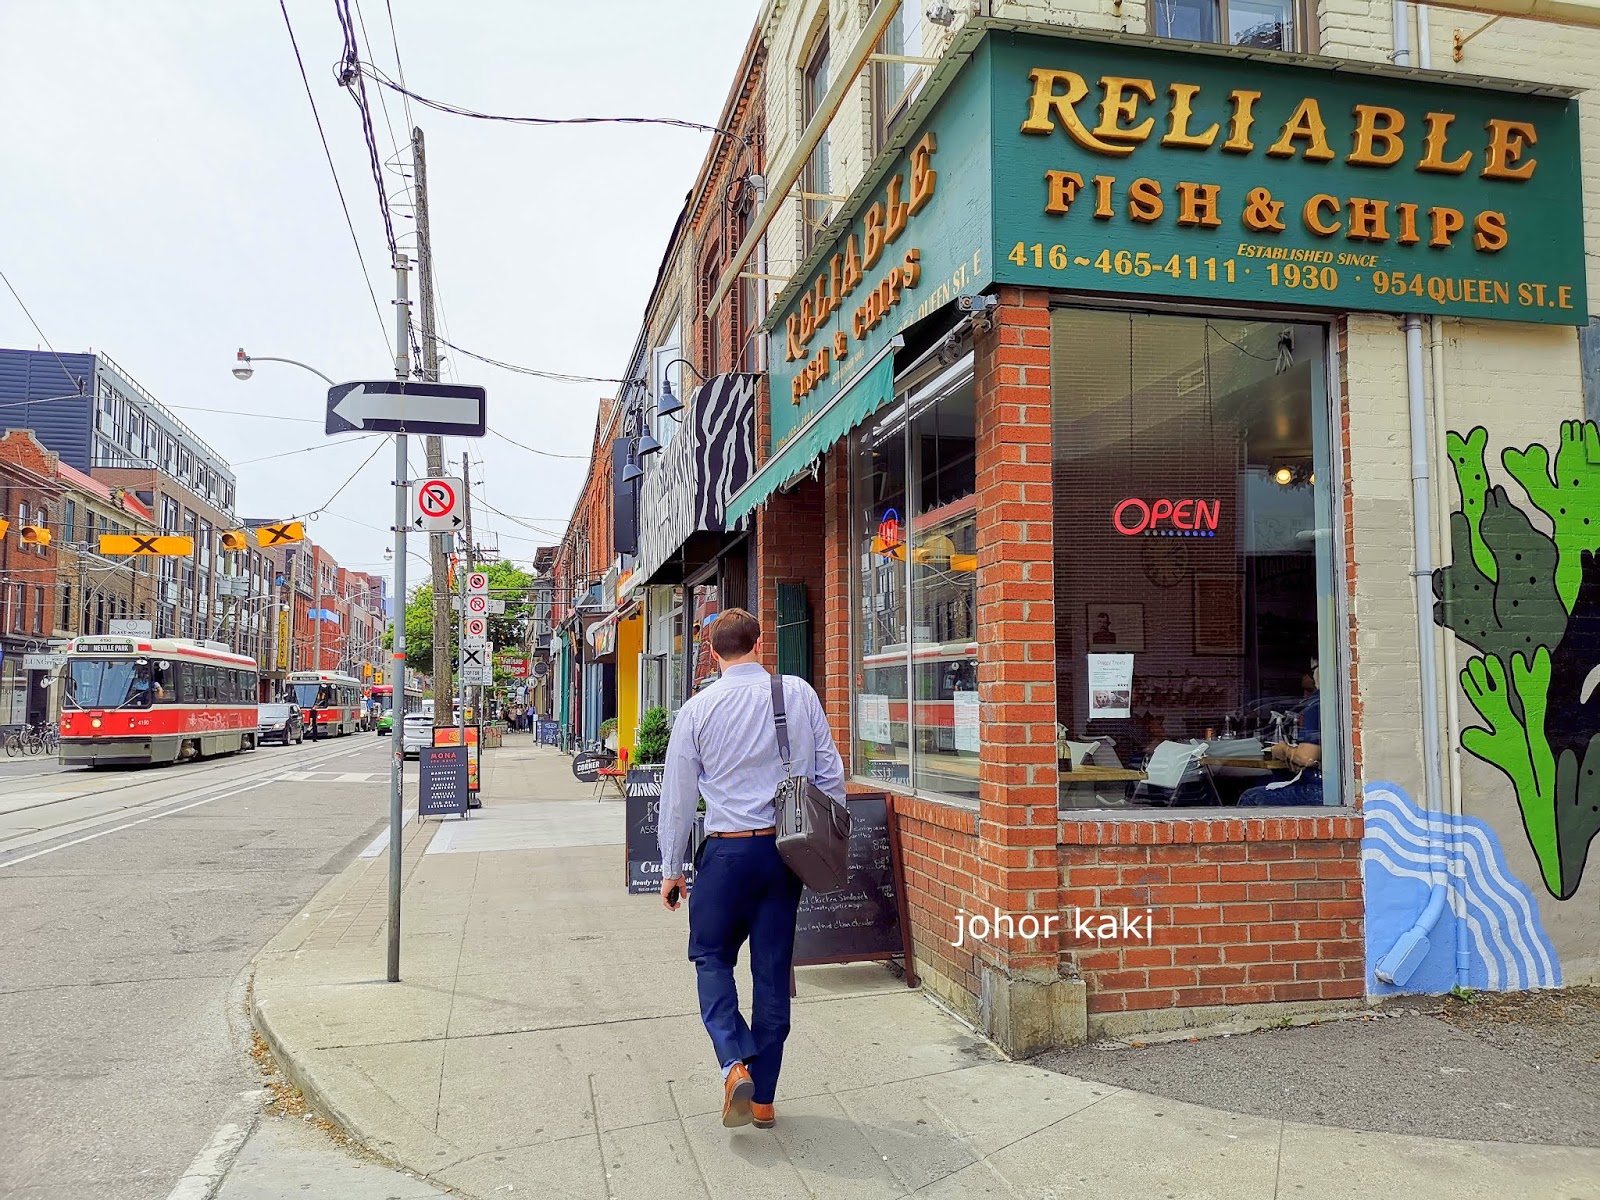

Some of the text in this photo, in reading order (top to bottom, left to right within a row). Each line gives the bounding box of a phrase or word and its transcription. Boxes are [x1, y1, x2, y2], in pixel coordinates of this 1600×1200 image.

[1021, 68, 1538, 182] RELIABLE
[1044, 169, 1509, 254] FISH & CHIPS
[785, 132, 936, 362] RELIABLE
[973, 249, 982, 276] E
[1236, 243, 1378, 268] ESTABLISHED SINCE
[1266, 262, 1338, 291] 1930
[791, 346, 830, 405] FISH
[833, 331, 847, 361] &
[853, 248, 921, 340] CHIPS
[1113, 497, 1221, 536] OPEN
[93, 644, 114, 652] NEVILLE
[115, 644, 129, 652] PARK
[577, 761, 600, 771] CORNER
